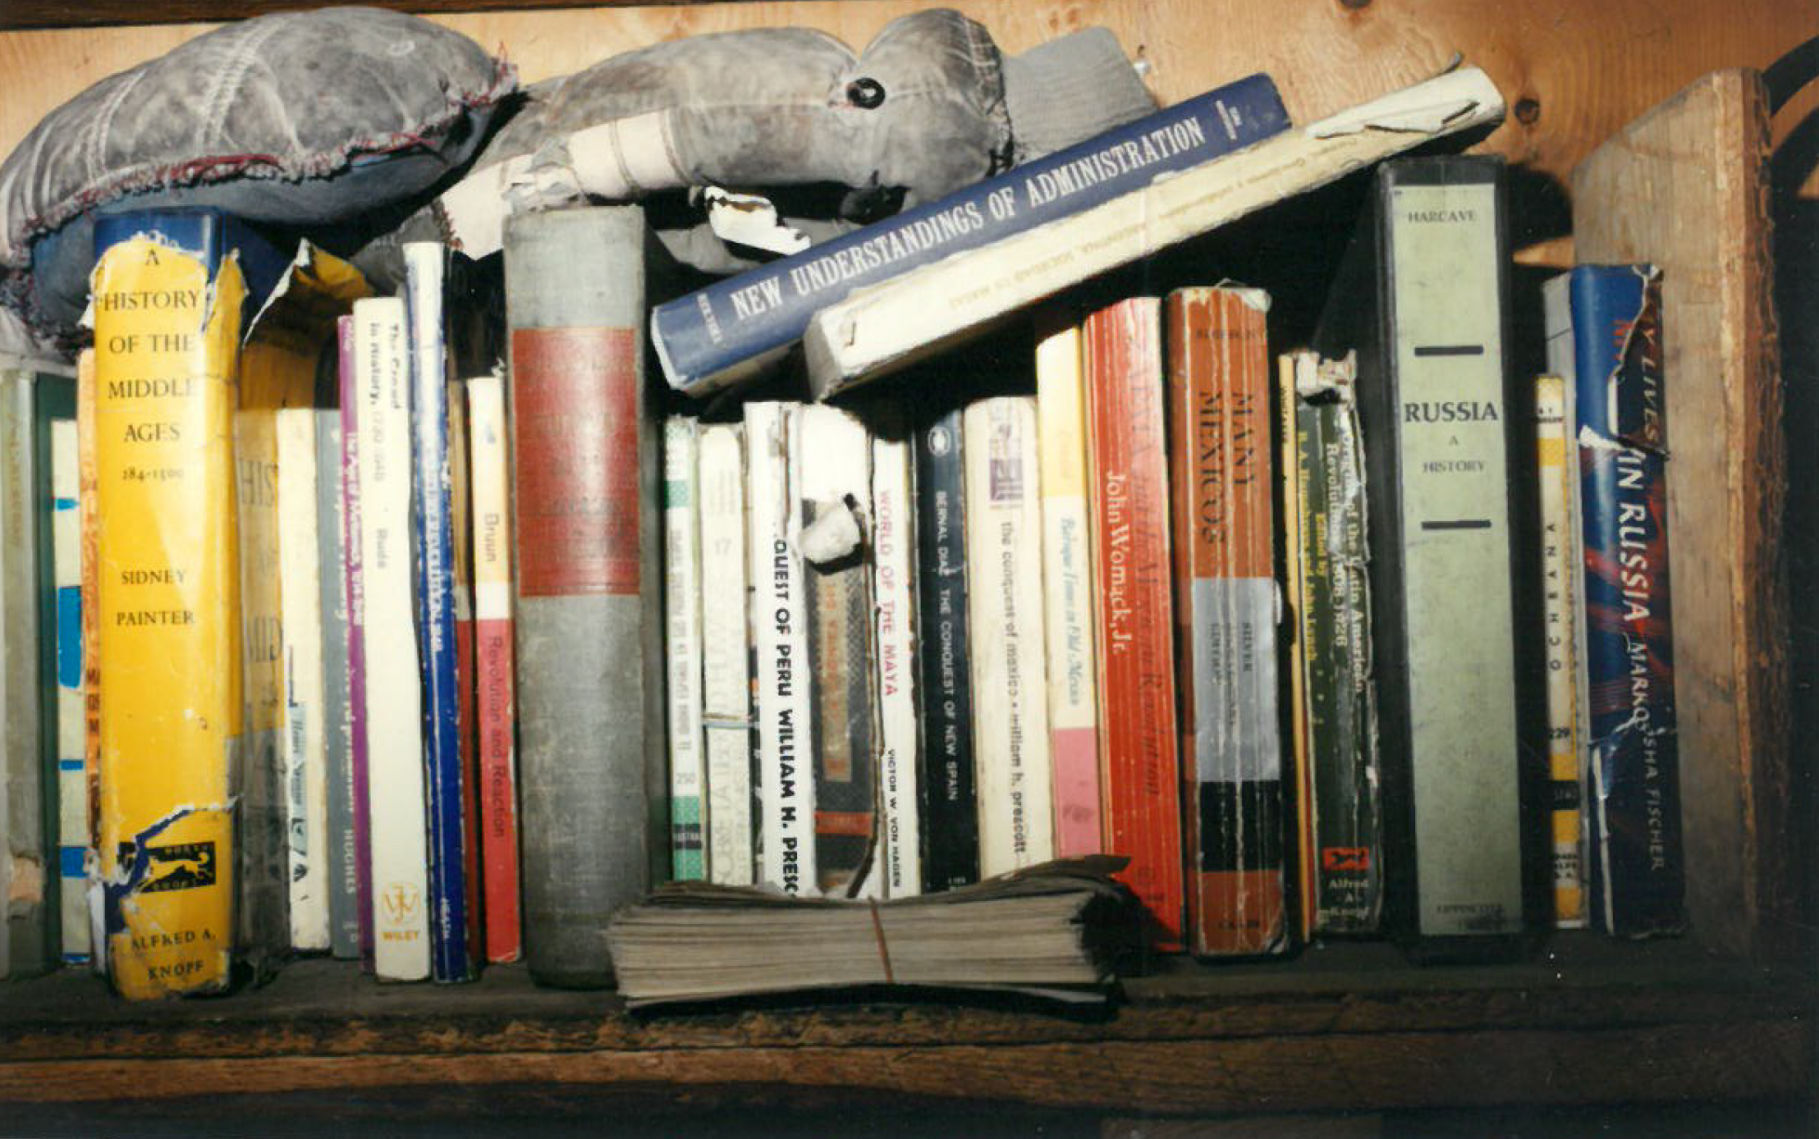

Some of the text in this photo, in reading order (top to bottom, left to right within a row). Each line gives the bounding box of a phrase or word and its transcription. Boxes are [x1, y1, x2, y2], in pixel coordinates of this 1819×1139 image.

[730, 276, 783, 320] NEW
[789, 201, 983, 296] UNDERSTANDINGS
[988, 187, 1016, 221] OF
[1025, 117, 1206, 208] ADMINISTRATION
[145, 249, 160, 266] A
[103, 289, 200, 312] HISTORY
[108, 334, 193, 354] OF THE
[1403, 401, 1500, 423] RUSSIA
[1641, 356, 1660, 443] LIVES
[123, 423, 182, 443] AGES
[1231, 392, 1255, 486] MANY
[1448, 435, 1460, 447] A
[1199, 391, 1225, 545] MEXICOS
[1421, 460, 1485, 474] HISTORY
[1106, 469, 1127, 514] John
[880, 490, 893, 556] WORLD
[936, 491, 948, 542] BERNAL
[1001, 521, 1012, 545] the
[1347, 522, 1360, 552] the
[120, 570, 187, 585] SIDNEY
[773, 540, 789, 601] QUEST
[881, 566, 894, 590] OF
[1002, 553, 1017, 619] conquest
[116, 611, 197, 626] PAINTER
[774, 607, 791, 635] OF
[940, 590, 951, 614] THE
[1006, 620, 1018, 638] of
[775, 643, 793, 697] PERU
[941, 623, 954, 695] CONQUEST
[1006, 643, 1019, 697] mexico
[1350, 608, 1366, 693] American
[883, 645, 898, 697] MAYA
[1618, 502, 1650, 621] RUSSIA
[1645, 789, 1665, 873] FISCHER
[944, 702, 955, 720] OF
[487, 636, 507, 838] Revolution and Reaction
[777, 708, 796, 799] WILLIAM
[944, 725, 957, 756] NEW
[1009, 713, 1024, 768] william
[887, 749, 897, 792] VICTOR
[947, 761, 958, 801] SPAIN
[780, 806, 797, 829] H.
[890, 816, 899, 843] VON
[1011, 791, 1027, 853] prescott
[344, 829, 356, 894] HUGHES
[892, 846, 902, 888] HAGEN
[131, 931, 196, 950] ALFRED
[381, 930, 420, 942] WILEY
[147, 960, 205, 980] KNOPF
